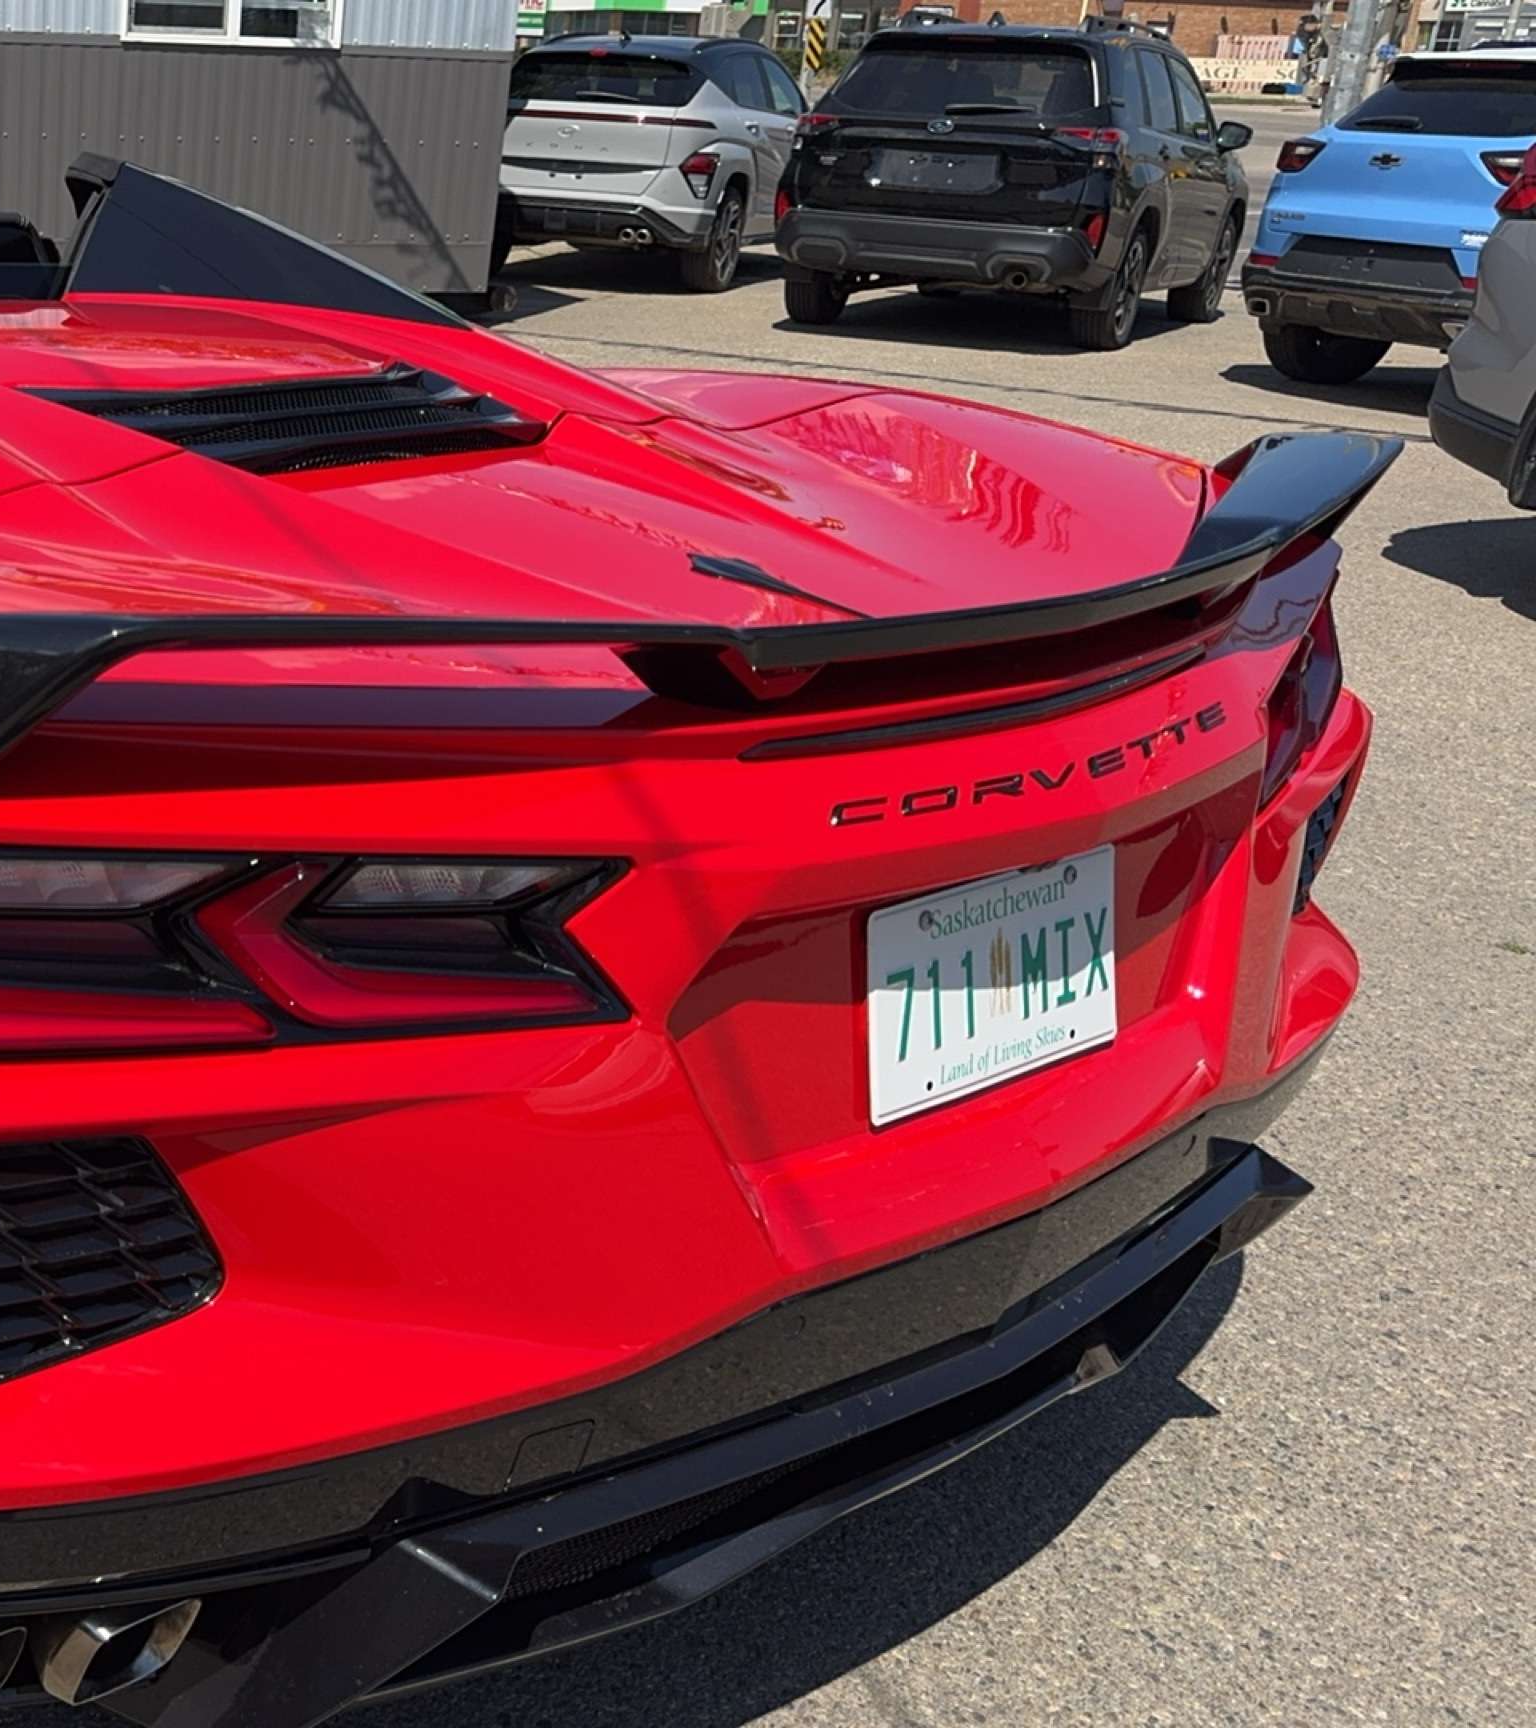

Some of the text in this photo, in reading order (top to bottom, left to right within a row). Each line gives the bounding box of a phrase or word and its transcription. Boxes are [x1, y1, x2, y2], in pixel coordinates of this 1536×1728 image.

[830, 702, 1226, 826] CORVETTE
[929, 880, 1065, 939] Saskatchewan
[886, 906, 1109, 1062] 711 MIX
[940, 1025, 1065, 1085] Land of Living Skies
